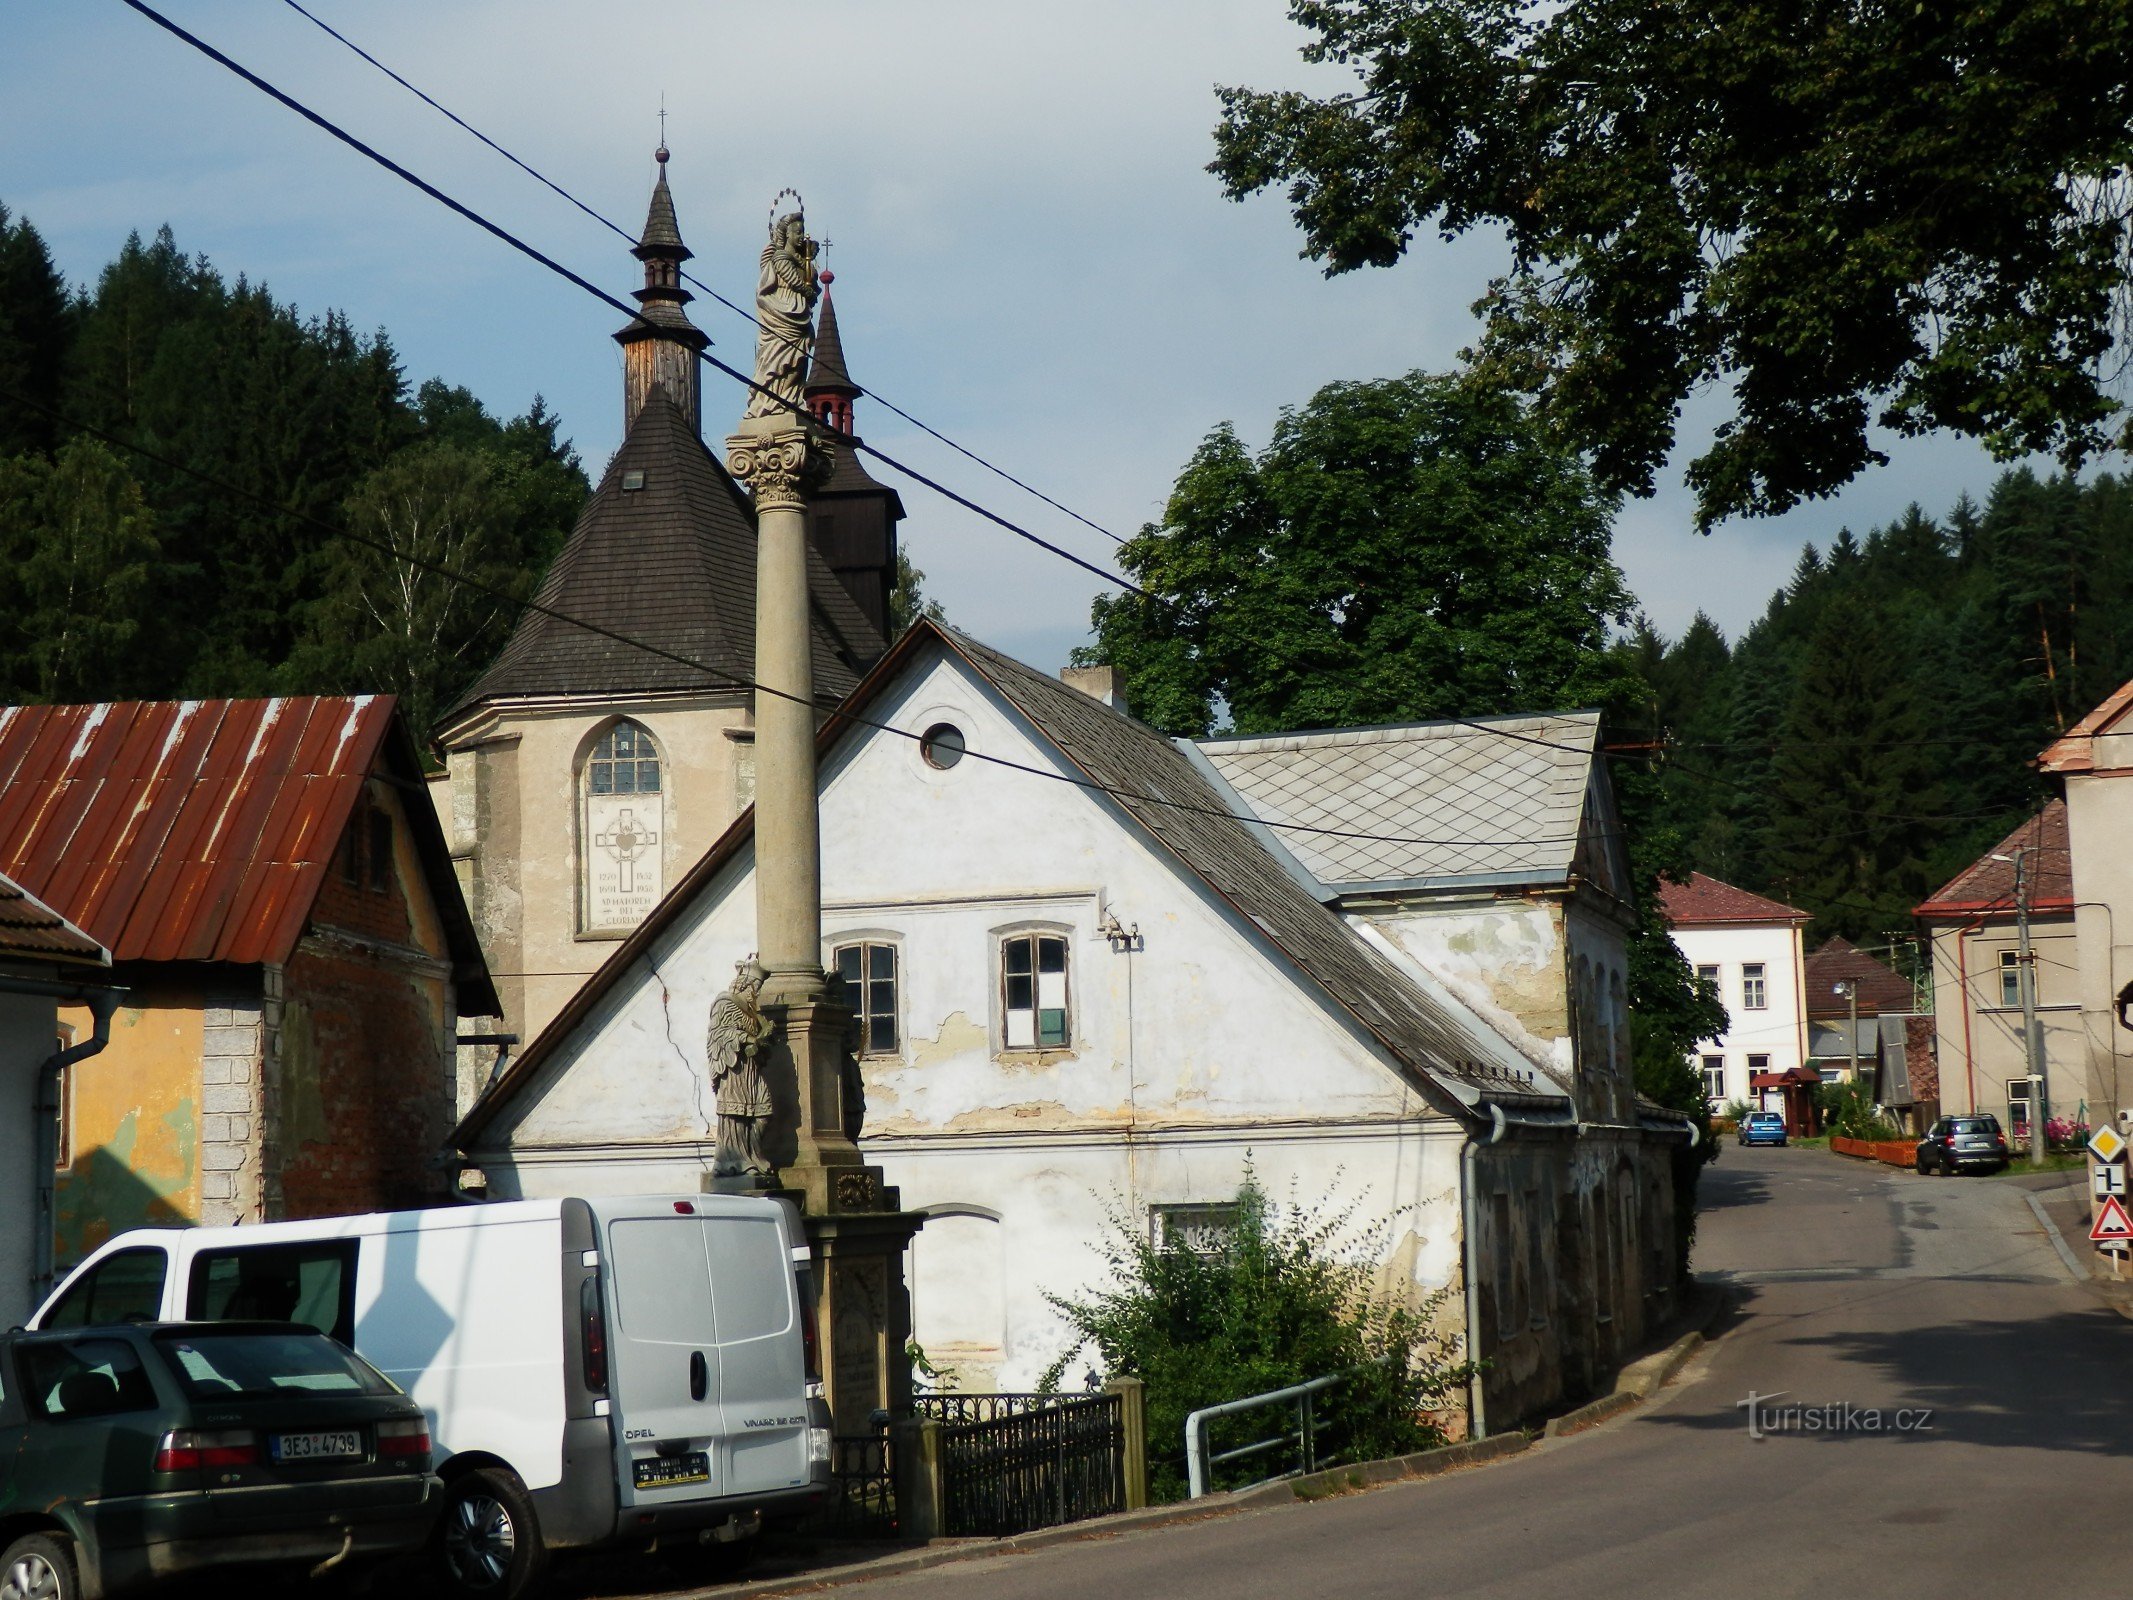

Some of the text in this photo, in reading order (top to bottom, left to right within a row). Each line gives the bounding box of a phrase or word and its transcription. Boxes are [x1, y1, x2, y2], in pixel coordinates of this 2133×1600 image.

[625, 1429, 656, 1439] OPEL
[284, 1434, 355, 1456] 3E3 4739
